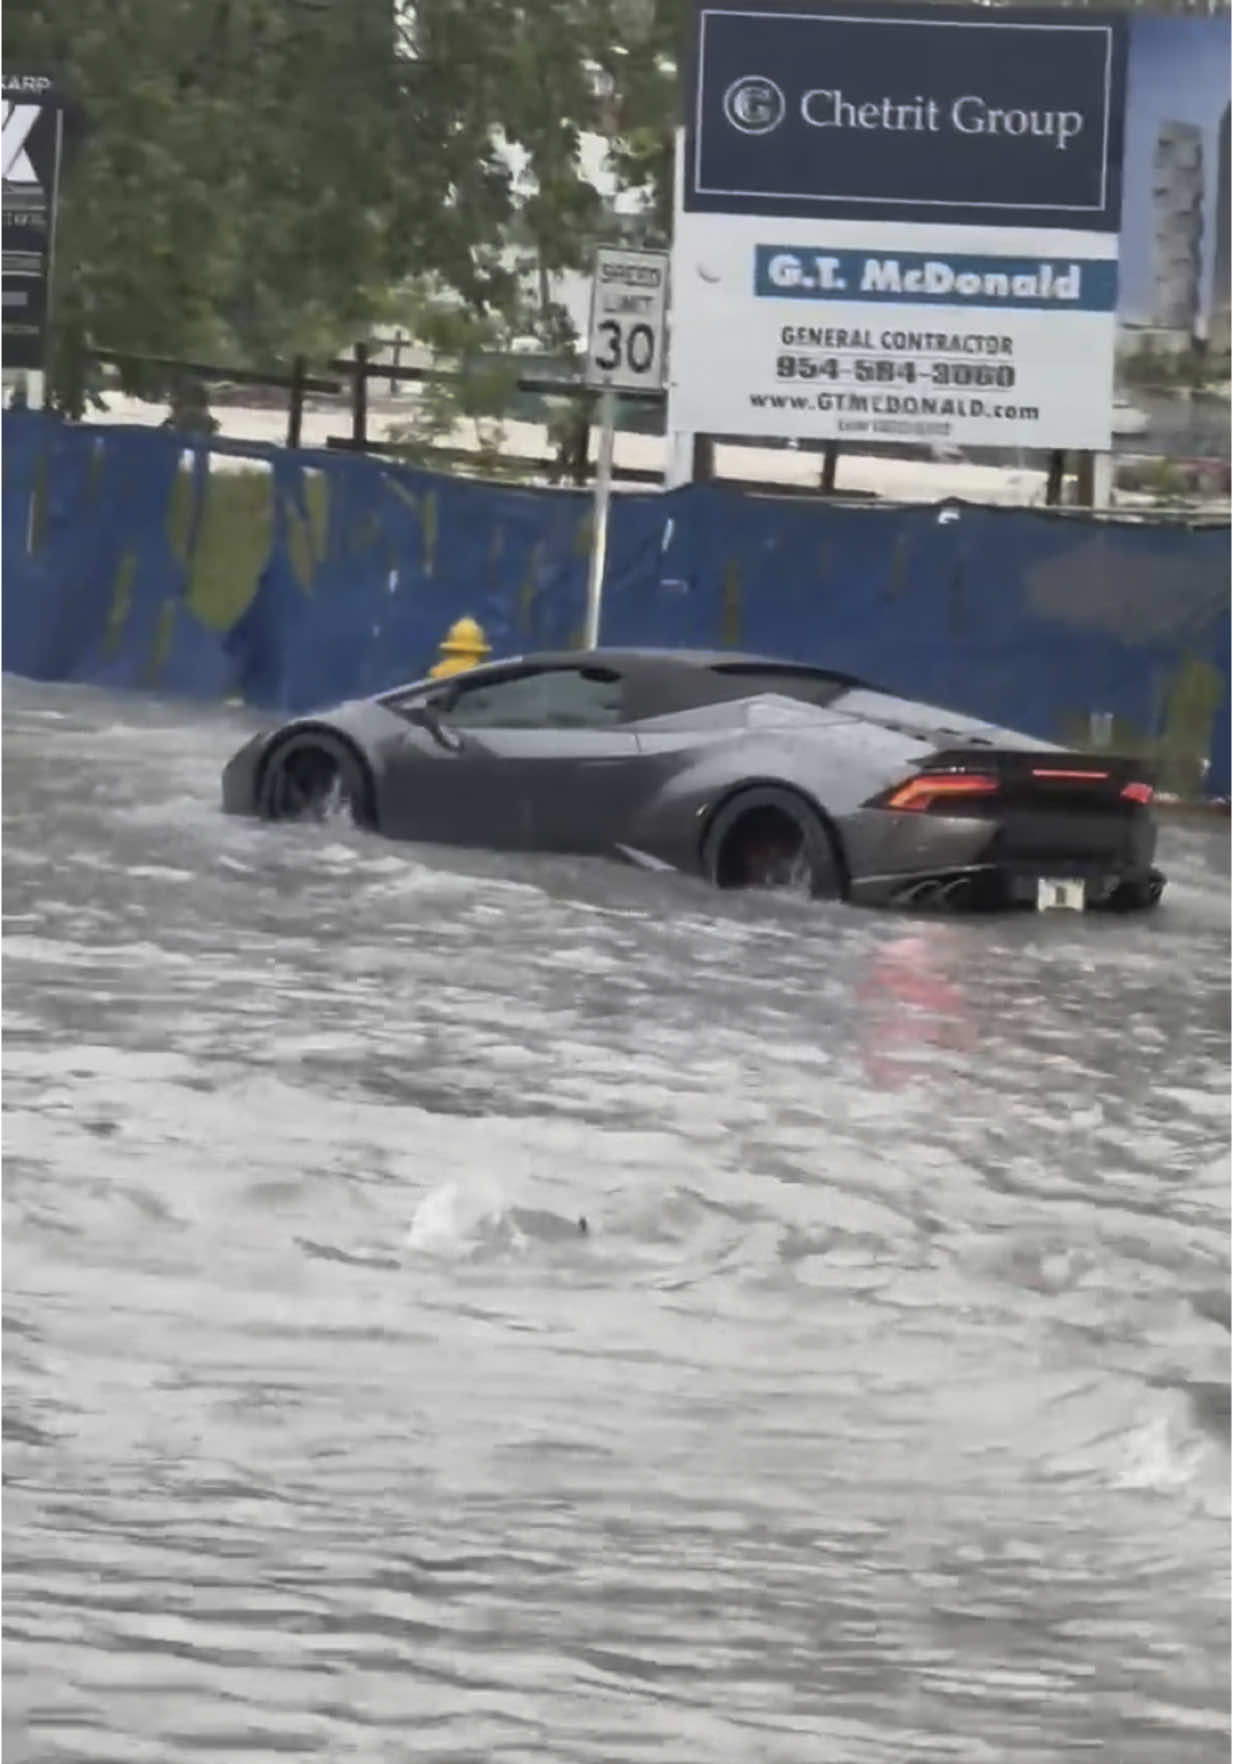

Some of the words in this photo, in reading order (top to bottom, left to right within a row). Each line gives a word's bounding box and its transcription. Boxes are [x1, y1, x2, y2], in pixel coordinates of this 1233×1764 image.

[800, 89, 940, 133] Chetrit
[951, 96, 1083, 149] Group
[768, 254, 846, 289] G.T.
[860, 259, 1081, 299] McDonald
[595, 319, 655, 373] 30
[781, 326, 875, 349] GENERAL
[880, 331, 1014, 356] CONTRACTOR
